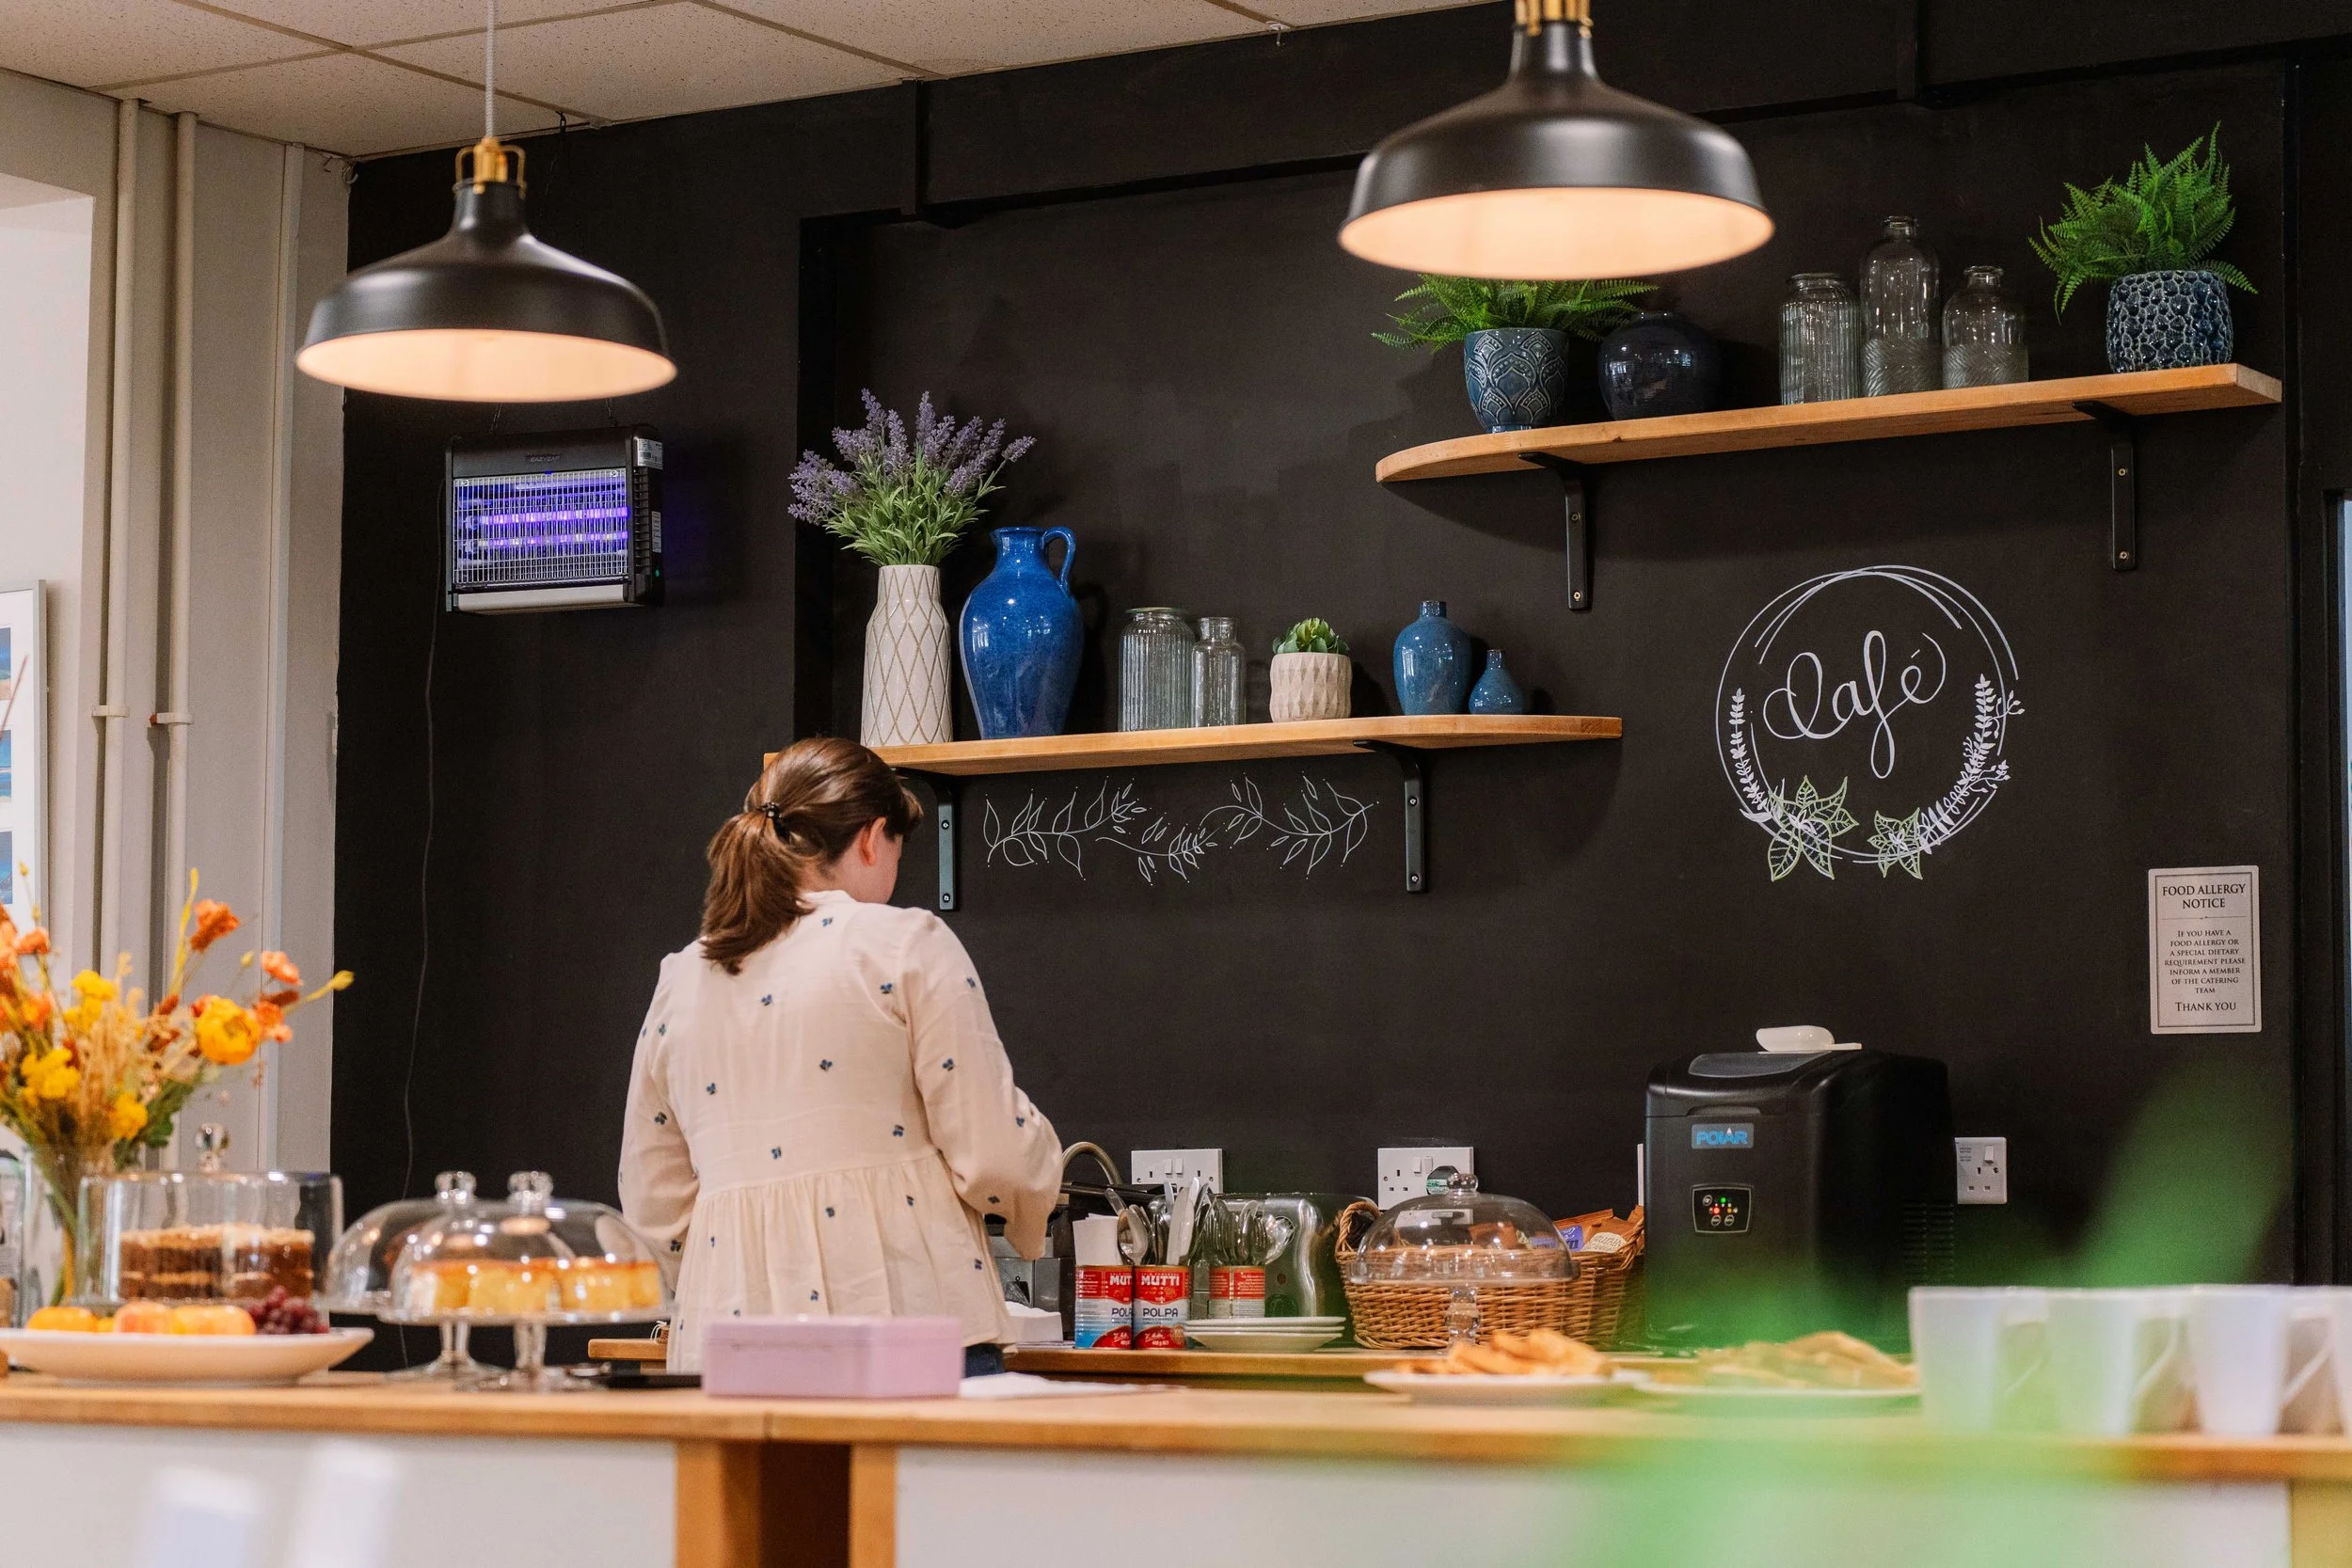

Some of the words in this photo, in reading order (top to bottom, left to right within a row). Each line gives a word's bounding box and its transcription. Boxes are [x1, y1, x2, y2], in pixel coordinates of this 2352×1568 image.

[1762, 629, 1947, 779] Café
[2163, 885, 2195, 896] FOOD
[2199, 884, 2246, 895] ALLERGY
[2183, 898, 2225, 909] NOTICE
[2175, 1002, 2212, 1012] THANK
[2215, 1002, 2236, 1011] YOU
[1696, 1127, 1748, 1145] POLAR
[1109, 1275, 1133, 1286] MUT
[1140, 1275, 1181, 1287] MUTTI
[1142, 1307, 1179, 1318] POLPA
